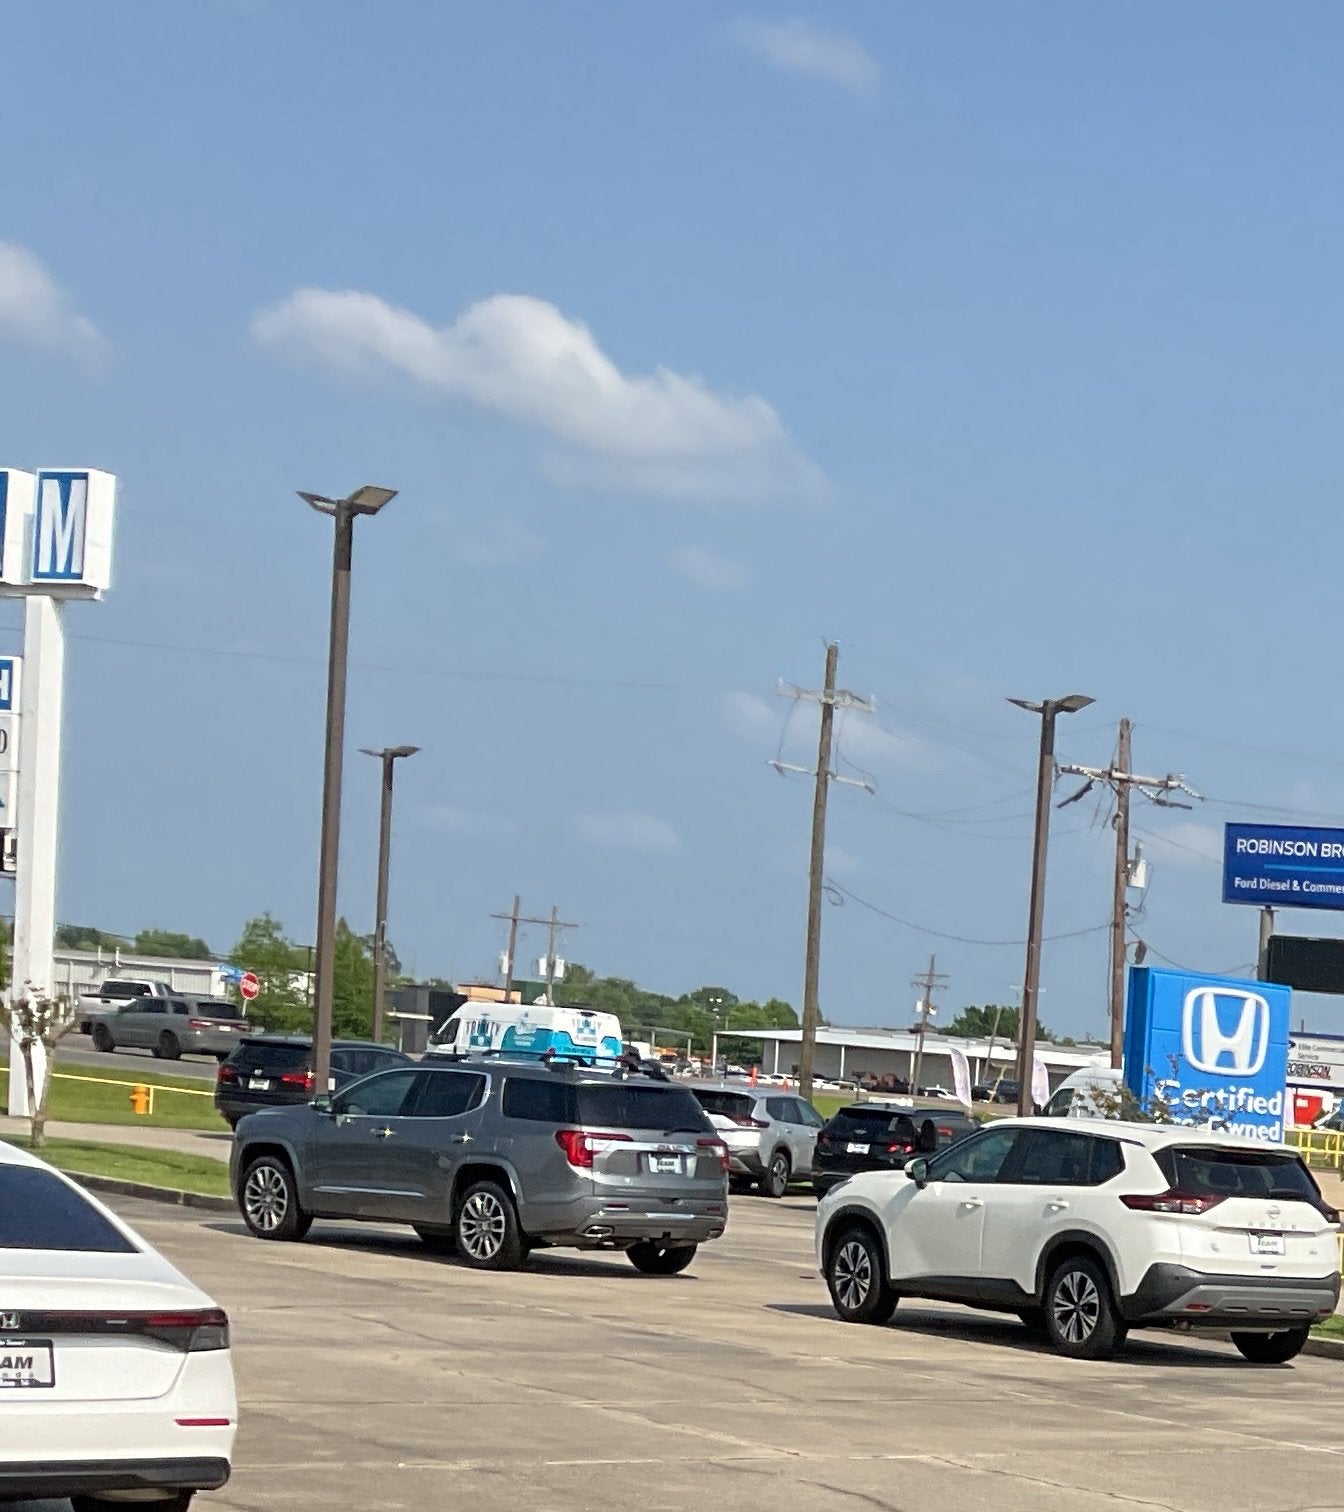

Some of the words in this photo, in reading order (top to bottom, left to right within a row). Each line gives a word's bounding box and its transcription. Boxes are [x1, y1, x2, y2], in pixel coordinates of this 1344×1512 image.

[1236, 838, 1318, 857] ROBINSON
[1234, 877, 1257, 889] Ford
[1259, 878, 1291, 891] Diesel
[1292, 880, 1300, 891] &
[1154, 1079, 1283, 1116] Certified
